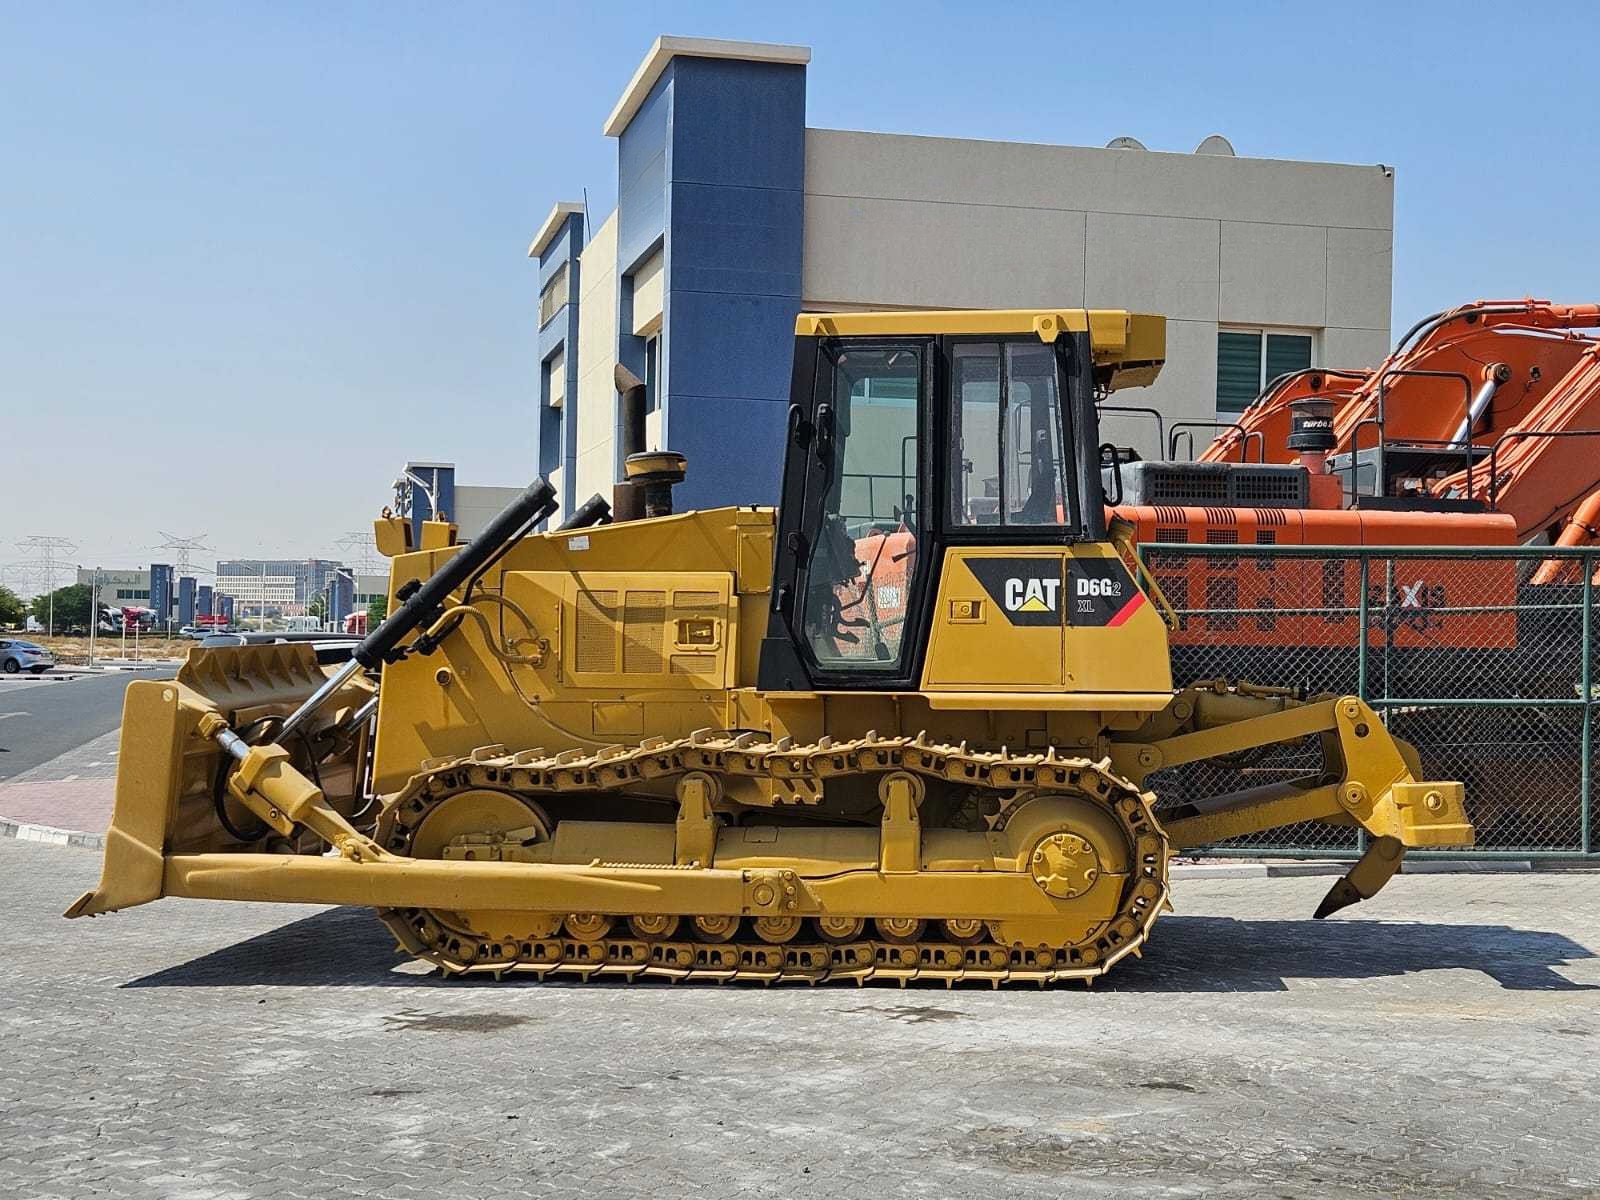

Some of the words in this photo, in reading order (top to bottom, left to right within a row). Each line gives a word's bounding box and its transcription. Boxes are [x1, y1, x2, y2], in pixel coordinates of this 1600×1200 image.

[1303, 420, 1328, 428] turbo
[1005, 578, 1060, 611] CAT
[1076, 578, 1122, 596] D6G2
[1077, 600, 1095, 613] XL
